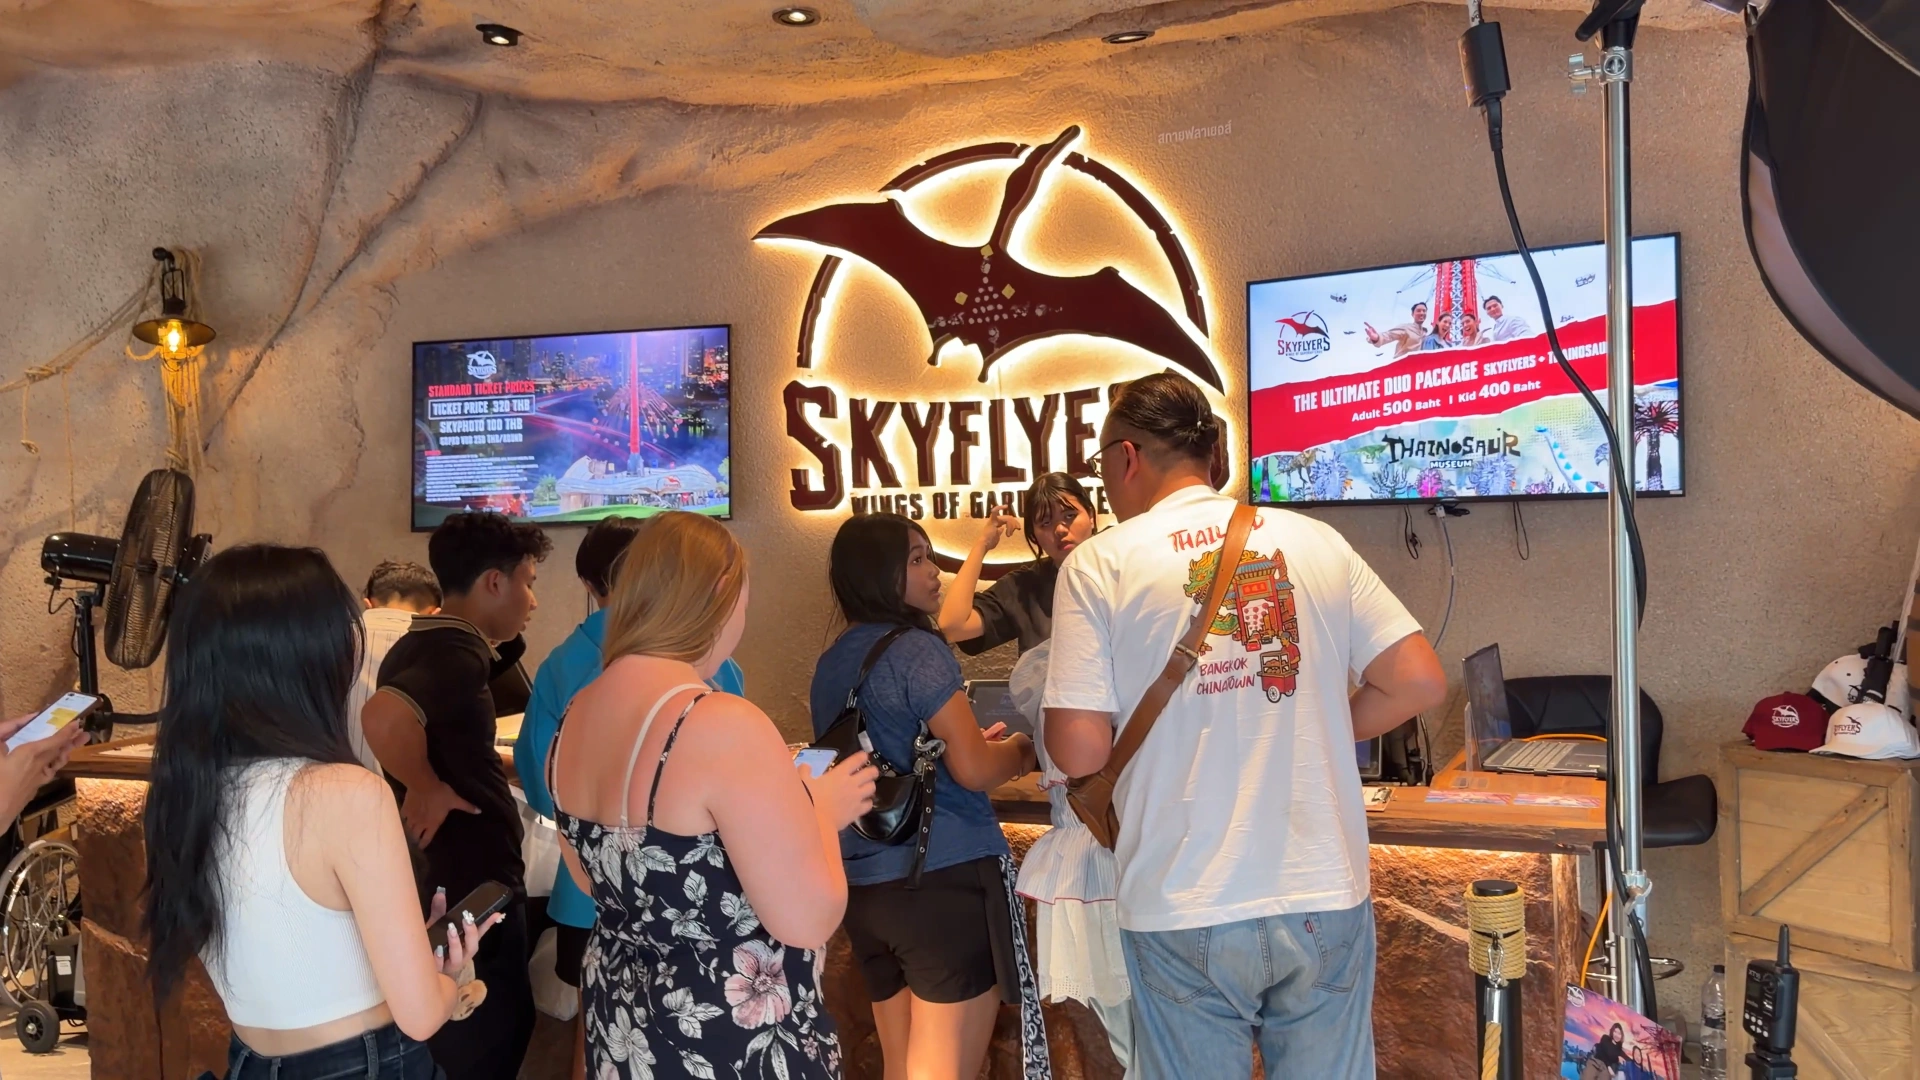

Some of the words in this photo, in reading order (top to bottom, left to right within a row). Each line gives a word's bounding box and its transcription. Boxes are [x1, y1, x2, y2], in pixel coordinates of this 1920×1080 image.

[1277, 337, 1331, 355] SKYFLYERS
[1293, 391, 1318, 412] THE
[1321, 379, 1381, 407] ULTIMATE
[1384, 374, 1411, 396] DUO
[1415, 361, 1479, 390] PACKAGE
[1483, 355, 1536, 376] SKYFLYERS
[1547, 341, 1609, 364] TAINOSAU
[428, 384, 472, 397] STANDARD
[474, 382, 503, 395] TICKET
[505, 380, 535, 393] PRICES
[432, 402, 463, 415] TICKET
[463, 401, 488, 414] PRICE
[492, 400, 510, 412] 320
[512, 399, 531, 411] THB
[1351, 409, 1381, 422] Adult
[1382, 399, 1412, 416] 500
[1415, 398, 1441, 410] Baht
[1458, 391, 1477, 403] Kid
[1478, 381, 1510, 399] 400
[1513, 381, 1541, 393] Baht
[439, 420, 485, 433] SKYPHOTO
[486, 419, 503, 431] 100
[504, 417, 523, 430] THB
[783, 379, 1231, 511] SKYFLYE
[1382, 430, 1521, 464] THAINOSAUR
[1430, 460, 1473, 469] MUSEUM
[851, 493, 924, 520] WINGS
[933, 492, 960, 519] OF
[1168, 514, 1265, 552] THAILD
[1199, 657, 1249, 677] BANGKOK
[1196, 674, 1256, 695] CHINATOWN
